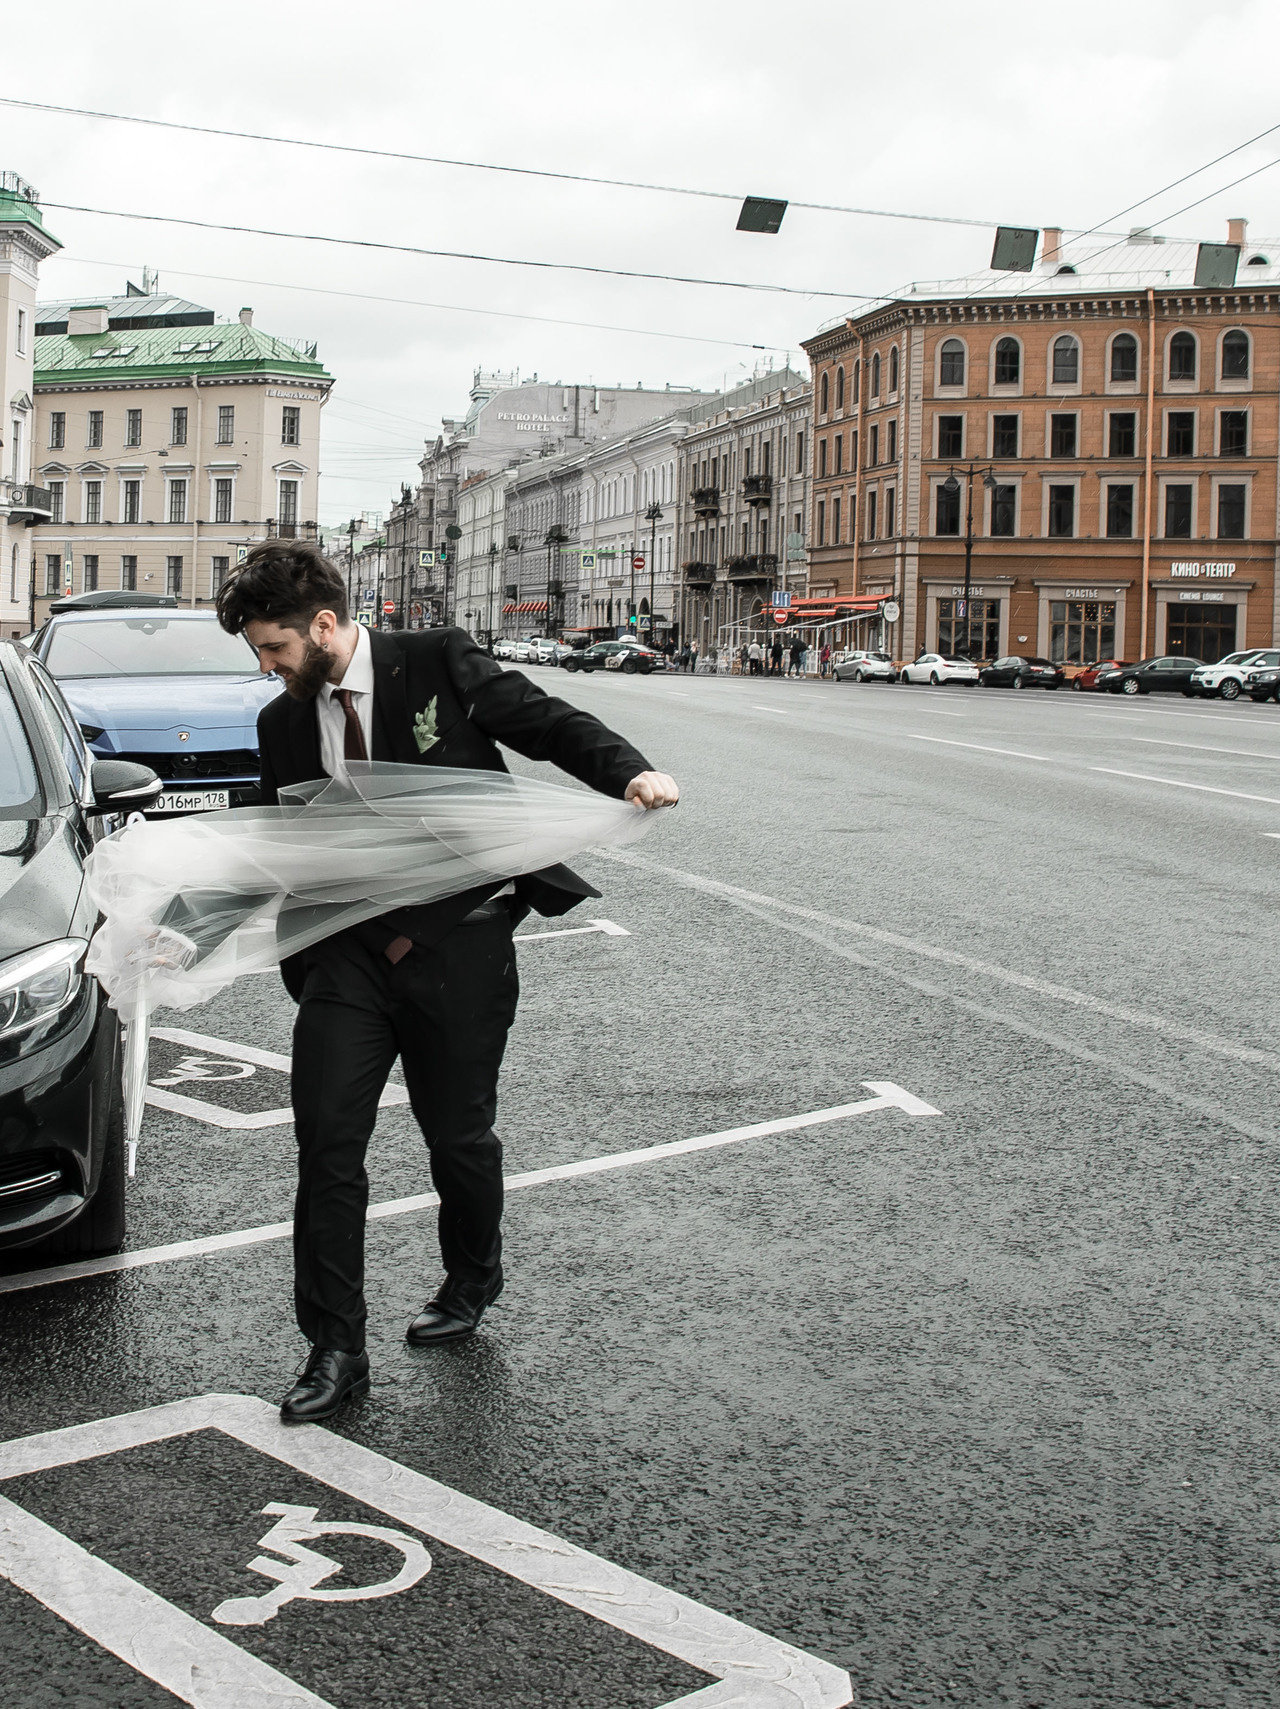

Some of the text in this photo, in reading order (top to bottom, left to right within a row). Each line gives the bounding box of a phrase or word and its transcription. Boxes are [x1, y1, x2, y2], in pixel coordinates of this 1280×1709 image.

[497, 412, 569, 423] PETRO PALACE
[516, 423, 550, 432] HOTEL
[1065, 588, 1098, 598] СЧАСТЬЕ
[205, 792, 225, 804] 178
